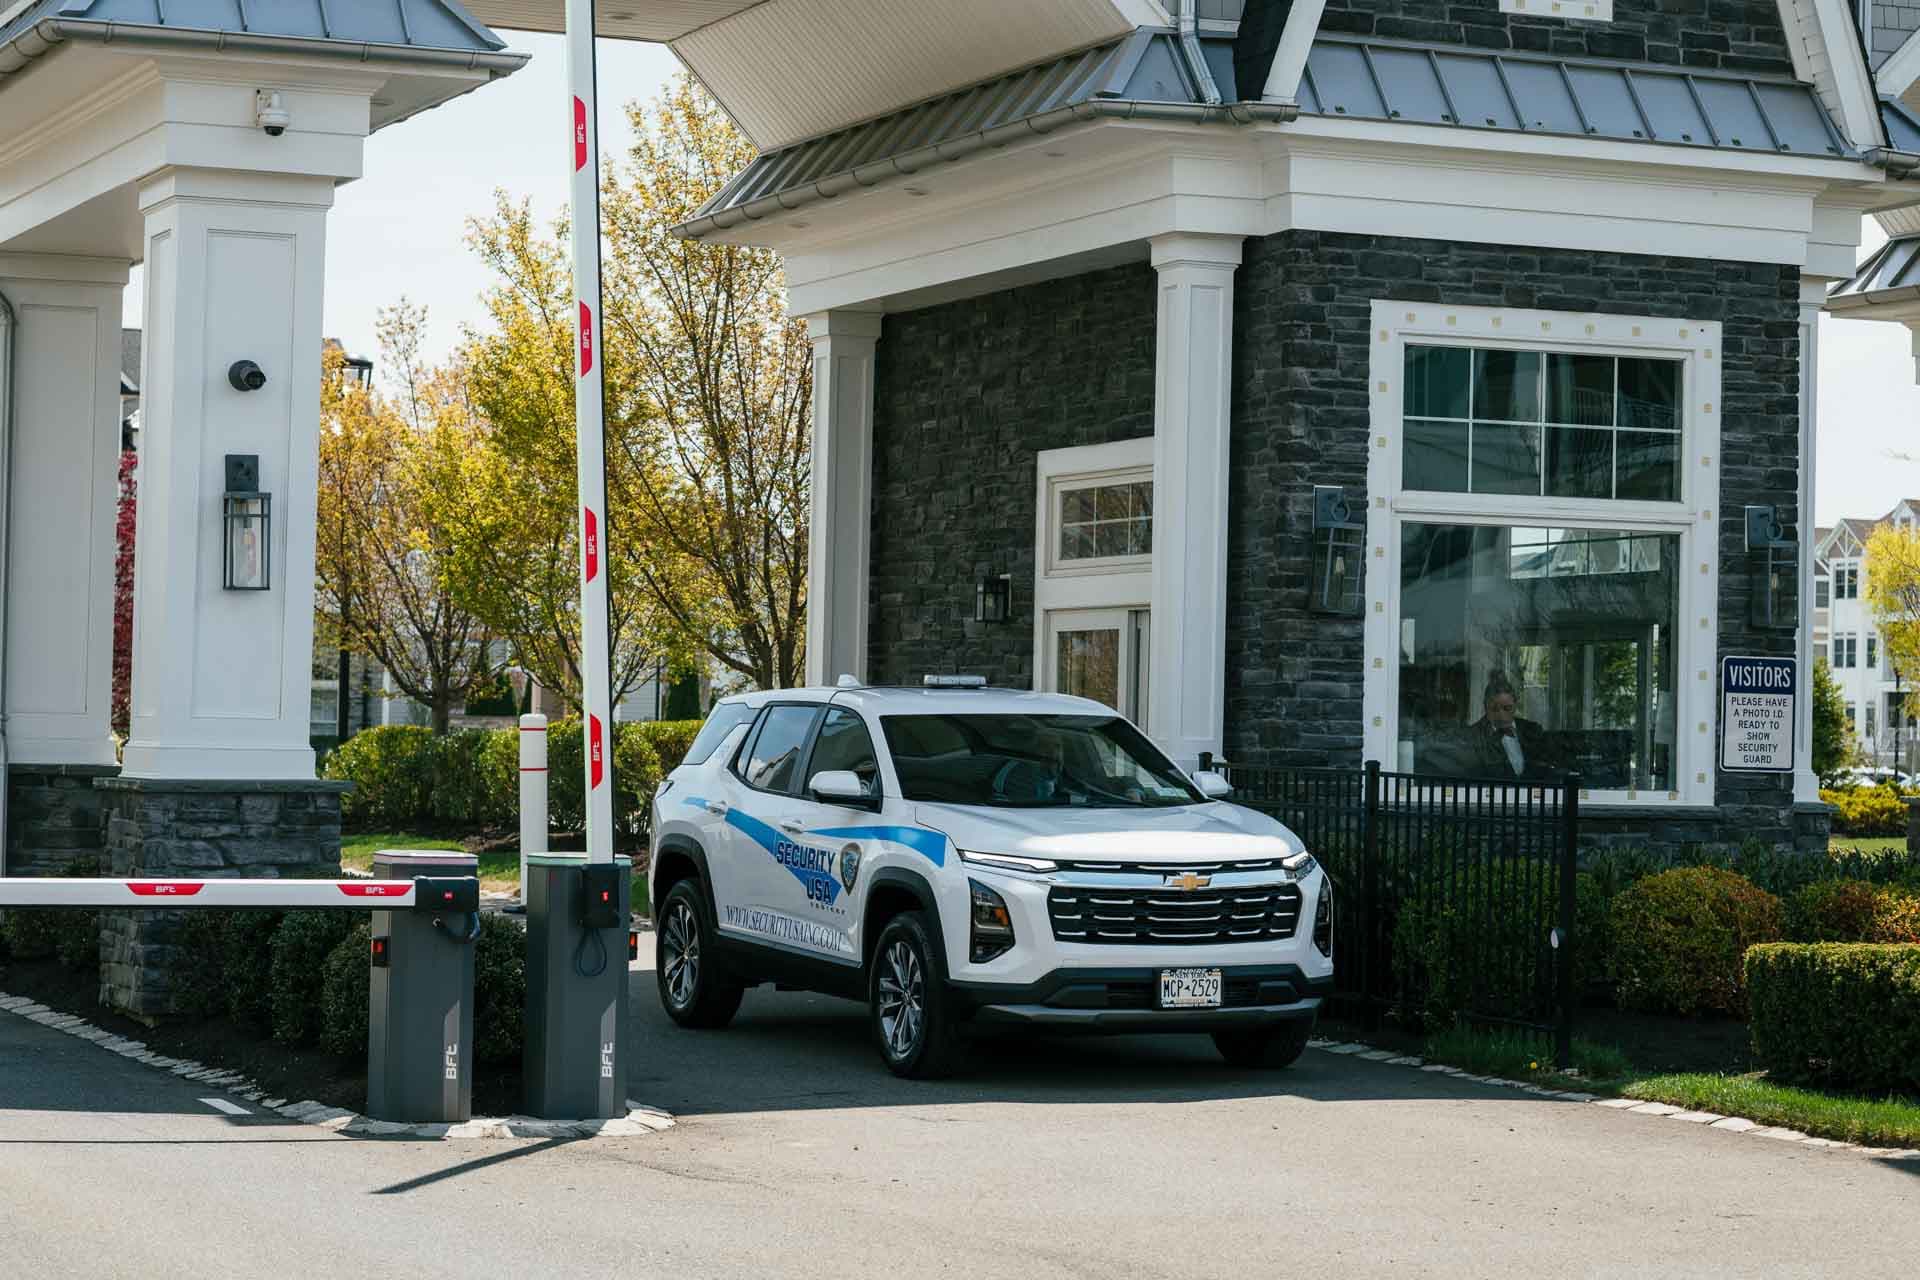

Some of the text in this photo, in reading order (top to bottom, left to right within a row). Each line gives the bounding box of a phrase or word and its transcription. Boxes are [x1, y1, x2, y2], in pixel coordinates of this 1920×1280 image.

[1730, 666, 1790, 688] VISITORS
[1732, 696, 1787, 706] PLEASE HAVE
[1734, 709, 1784, 718] A PHOTO I.D.
[1738, 720, 1780, 729] READY TO
[1747, 732, 1770, 740] SHOW
[1738, 744, 1778, 752] SECURITY
[1744, 755, 1772, 764] GUARD
[776, 842, 836, 873] SECURITY
[806, 877, 832, 904] USA
[1164, 979, 1218, 997] MCP 2529
